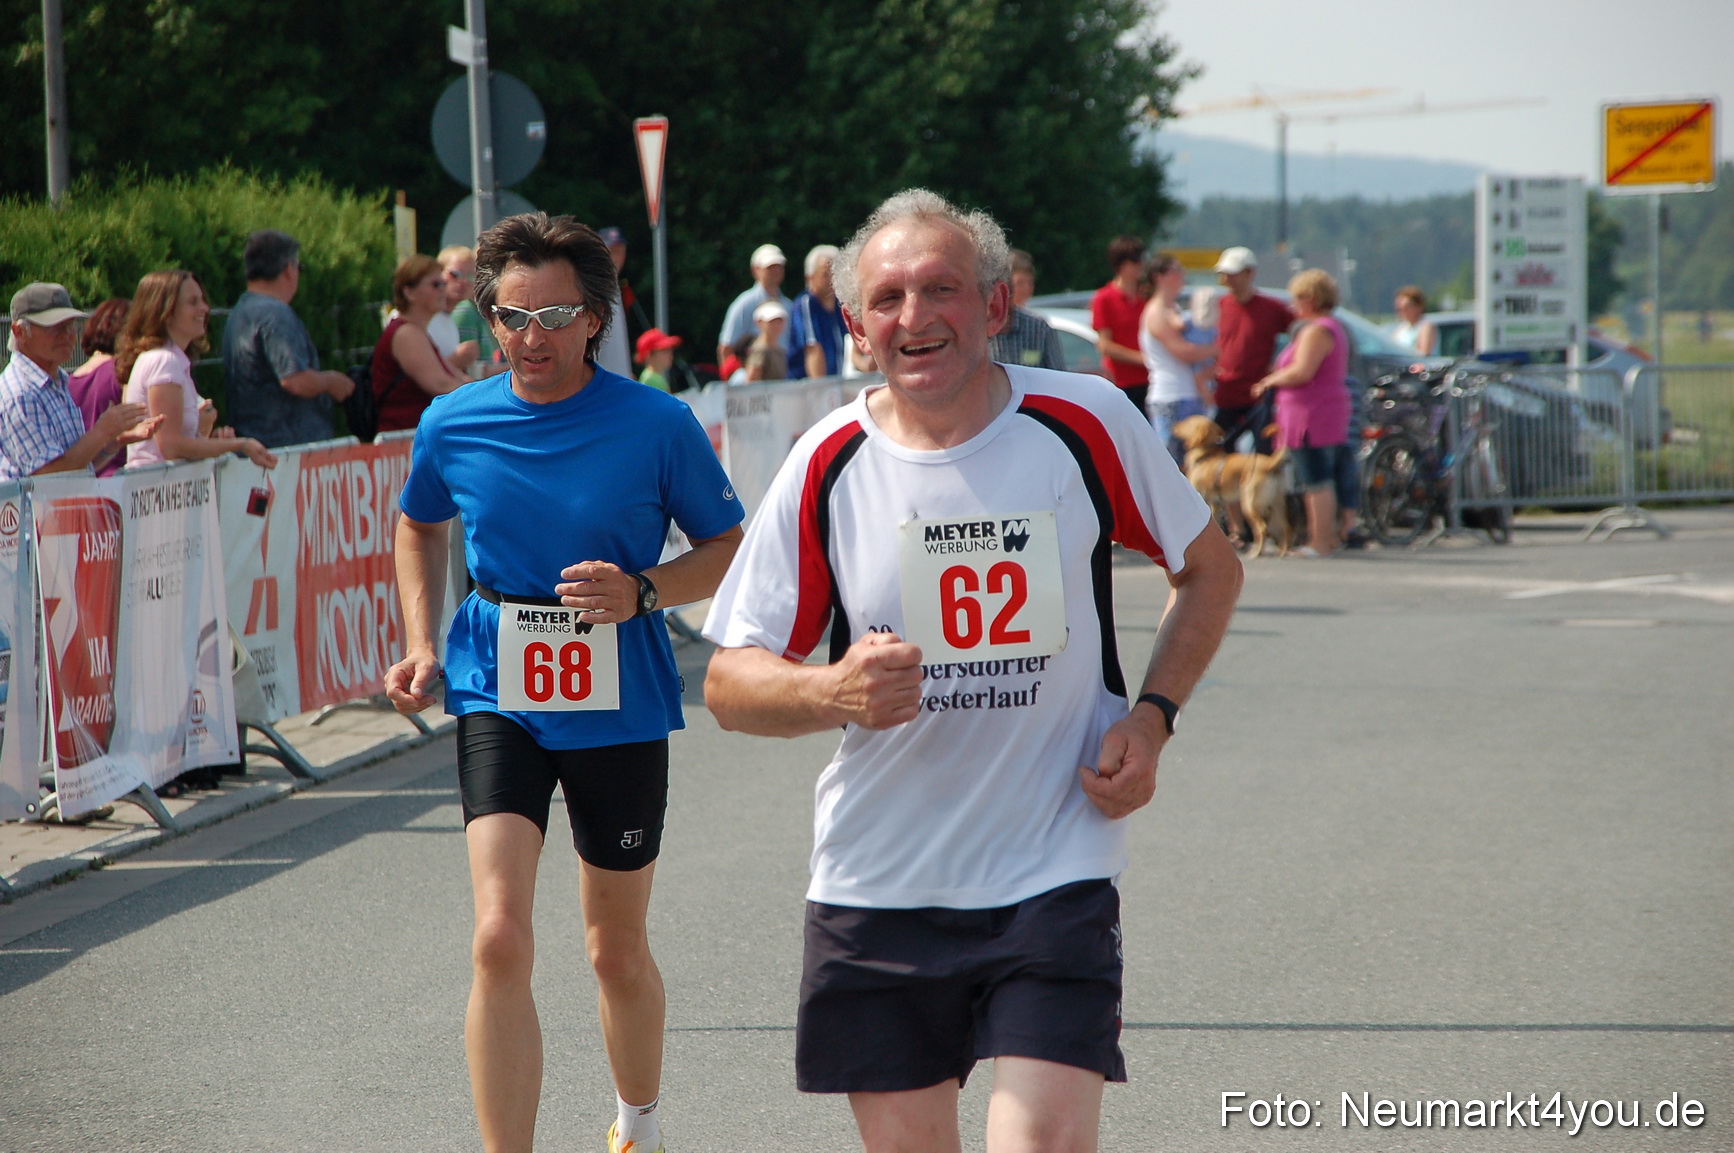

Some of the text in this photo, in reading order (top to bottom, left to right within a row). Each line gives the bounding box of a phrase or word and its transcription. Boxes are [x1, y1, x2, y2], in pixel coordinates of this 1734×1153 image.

[924, 521, 996, 541] MEYER
[925, 538, 998, 555] WERBUNG
[939, 560, 1031, 649] 62
[517, 609, 570, 623] MEYER
[517, 622, 571, 633] WERBUNG
[523, 641, 592, 702] 68
